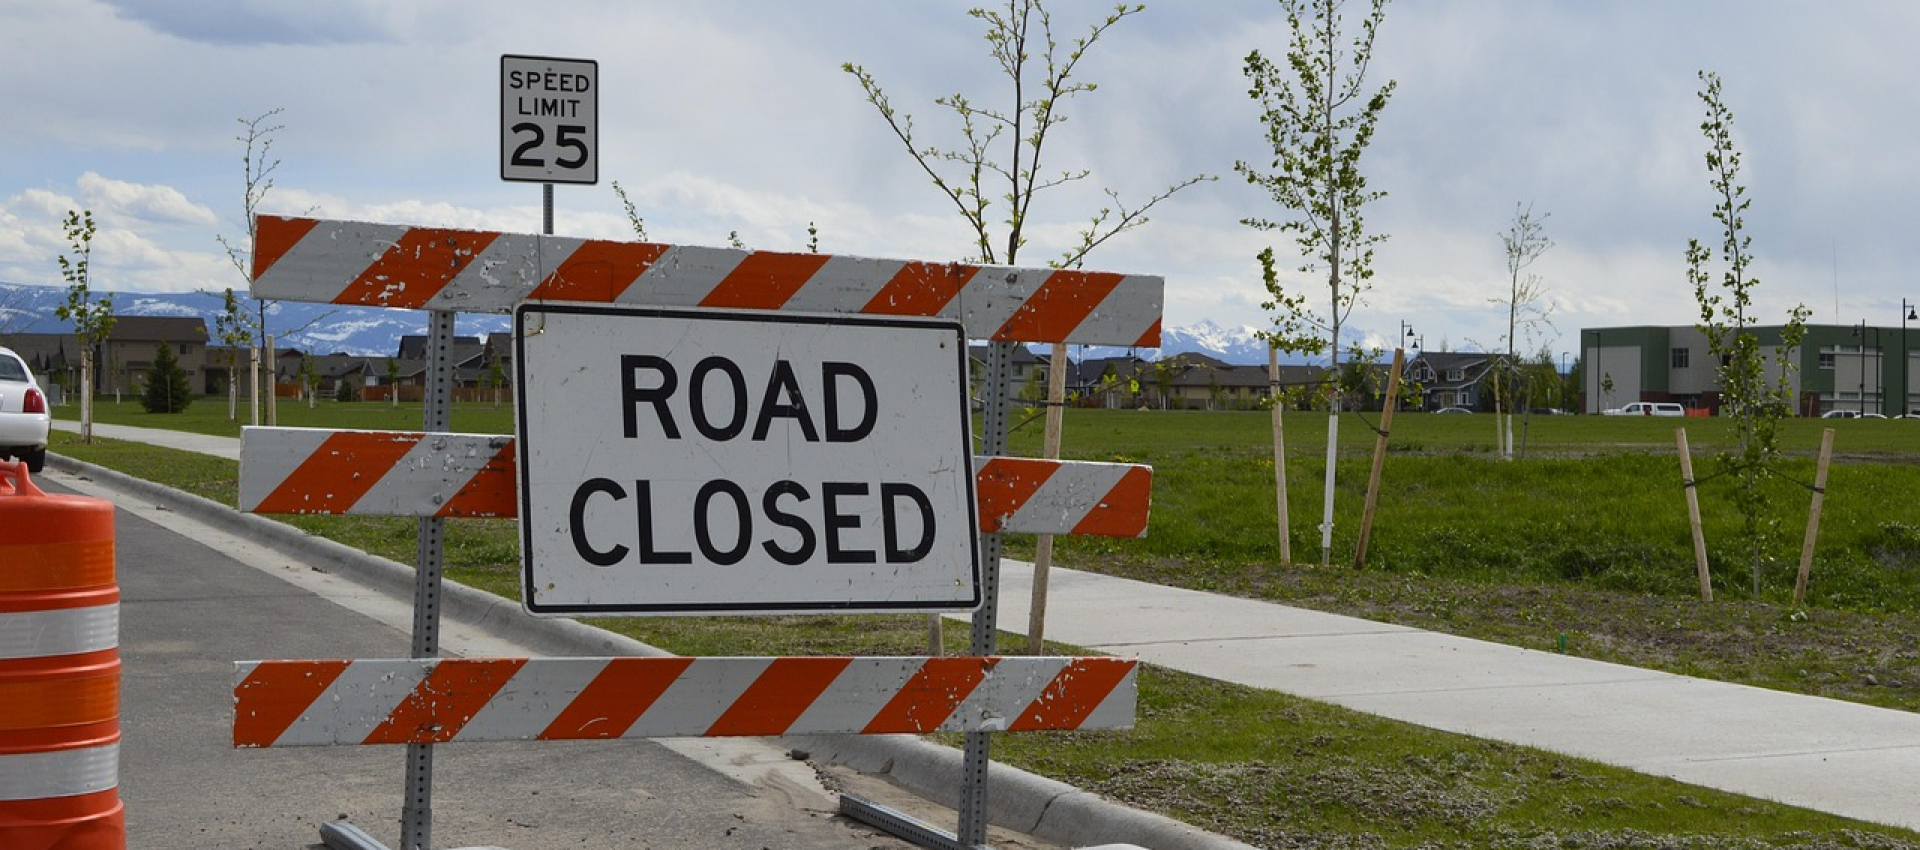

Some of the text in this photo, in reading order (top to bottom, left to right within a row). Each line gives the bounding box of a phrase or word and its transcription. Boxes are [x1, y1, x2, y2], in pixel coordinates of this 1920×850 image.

[510, 70, 590, 92] SPEED
[519, 97, 580, 118] LIMIT
[511, 122, 588, 169] 25
[621, 354, 878, 442] ROAD
[570, 478, 936, 566] CLOSED
